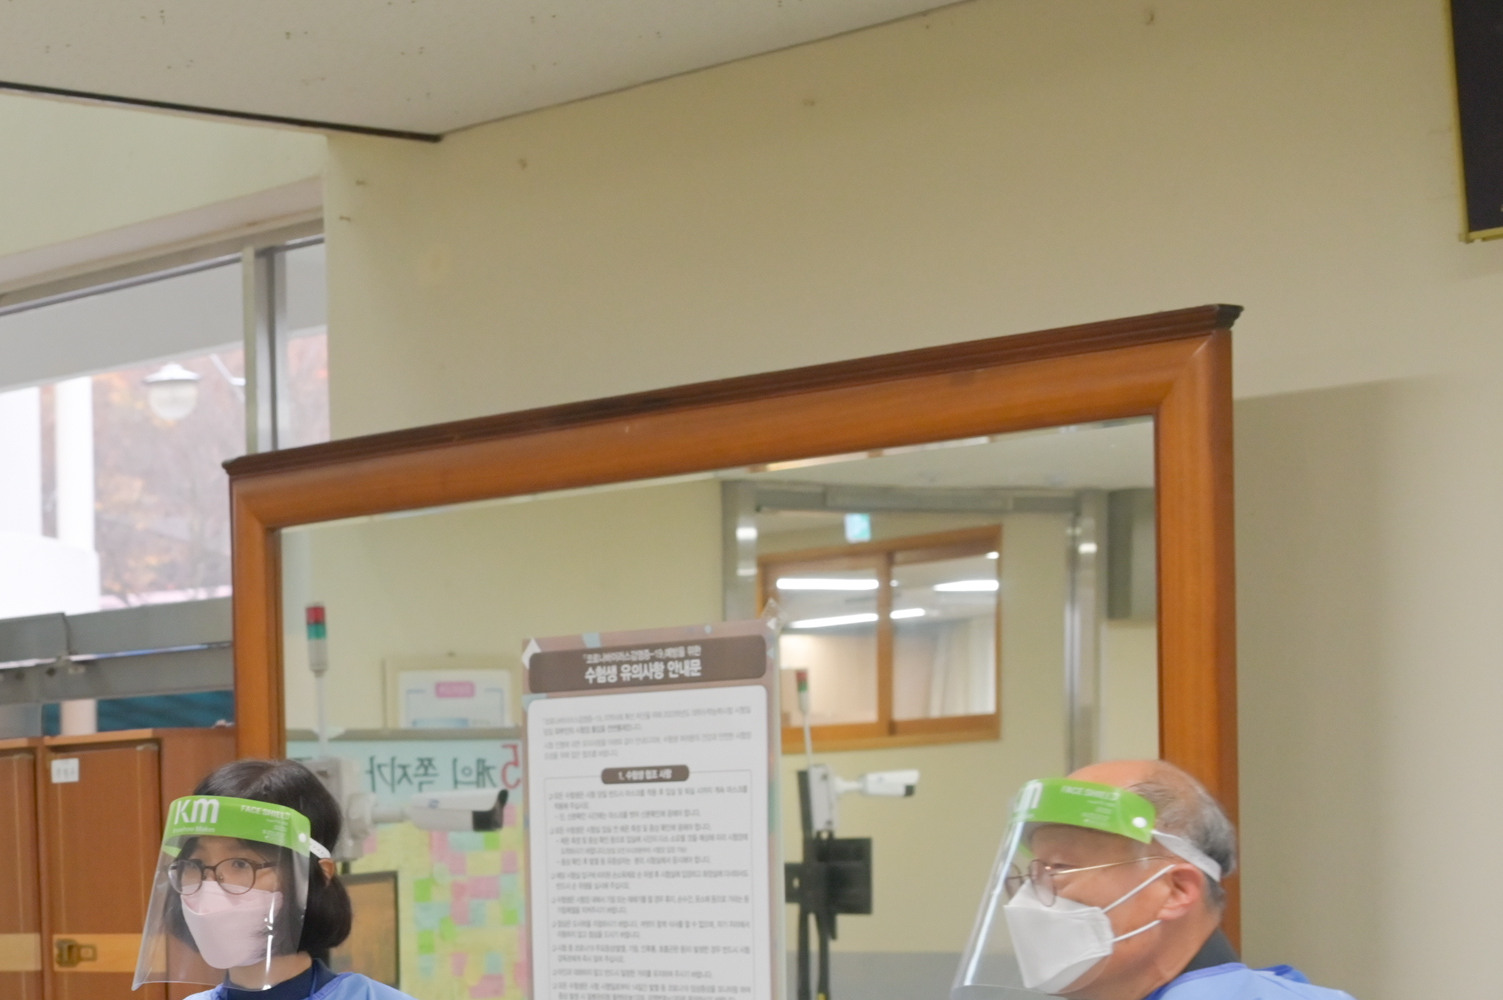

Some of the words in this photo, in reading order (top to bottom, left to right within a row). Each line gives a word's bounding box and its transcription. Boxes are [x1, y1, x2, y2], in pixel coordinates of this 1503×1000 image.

[584, 664, 618, 684] 수험생
[620, 661, 664, 681] 유의사항
[667, 659, 702, 679] 안내문
[1060, 785, 1084, 796] FACE
[241, 804, 262, 816] FACE
[262, 807, 291, 820] SHIELD
